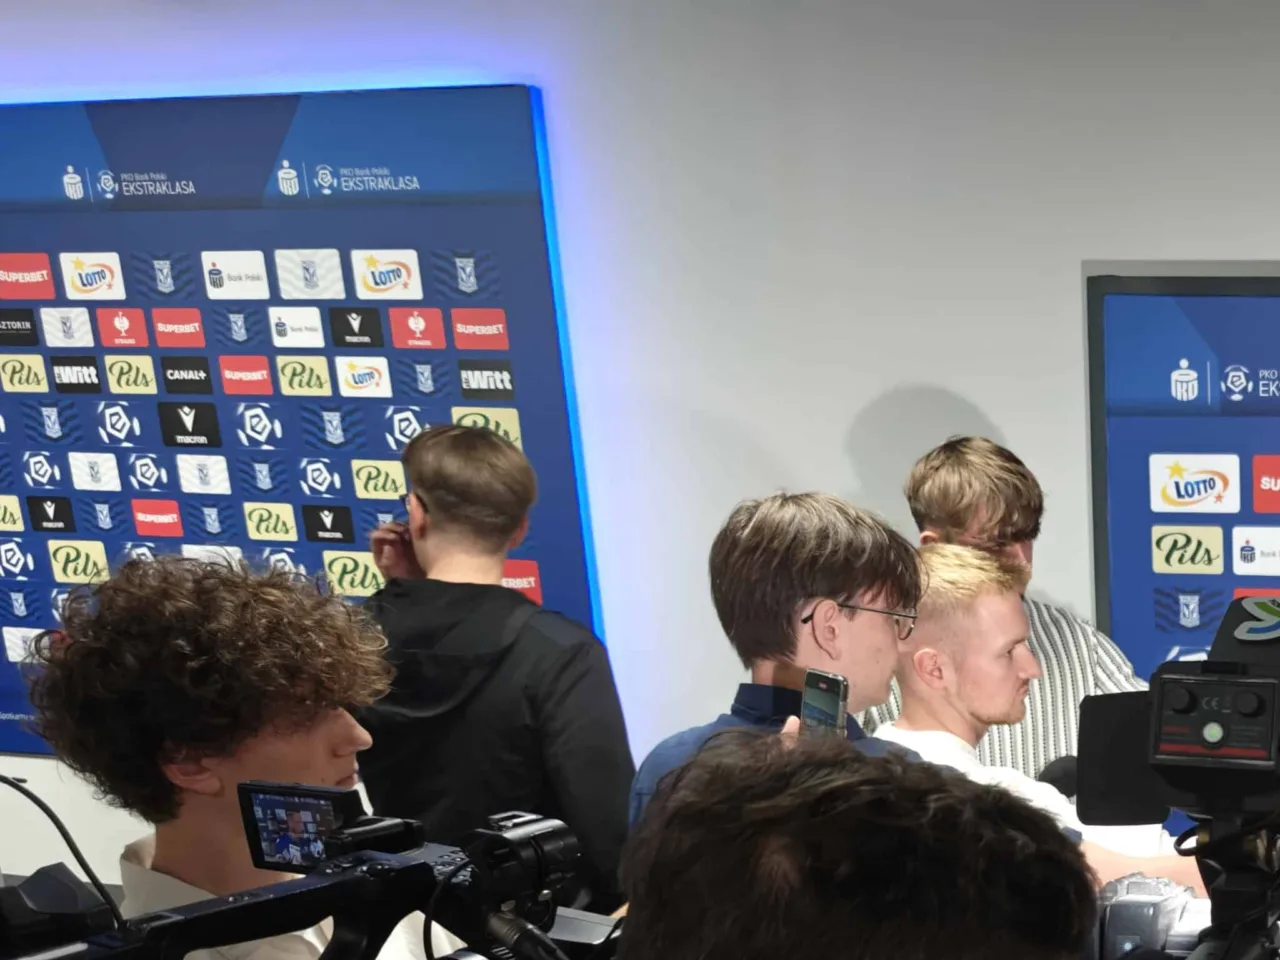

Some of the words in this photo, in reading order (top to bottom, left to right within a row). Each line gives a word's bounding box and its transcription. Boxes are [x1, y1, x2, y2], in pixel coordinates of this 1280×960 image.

[122, 181, 196, 196] EKSTRAKLASA
[341, 176, 420, 191] EKSTRAKLASA
[0, 270, 48, 283] SUPERBET
[78, 269, 106, 288] LOTTO
[371, 267, 402, 287] LOTTO
[157, 322, 200, 333] SUPERBET
[456, 323, 504, 335] SUPERBET
[2, 360, 45, 387] Pils
[108, 360, 154, 388] Pils
[166, 370, 207, 380] CANAL+
[224, 370, 267, 381] SUPERBET
[281, 361, 328, 390] Pils
[352, 371, 375, 386] LOTTO
[1259, 369, 1278, 379] PKO
[355, 465, 403, 494] Pils
[1174, 477, 1216, 499] LOTTO
[248, 508, 293, 535] Pils
[1155, 532, 1220, 567] Pils
[52, 545, 106, 578] Pils
[328, 556, 385, 592] Pils
[502, 577, 536, 588] ERBET
